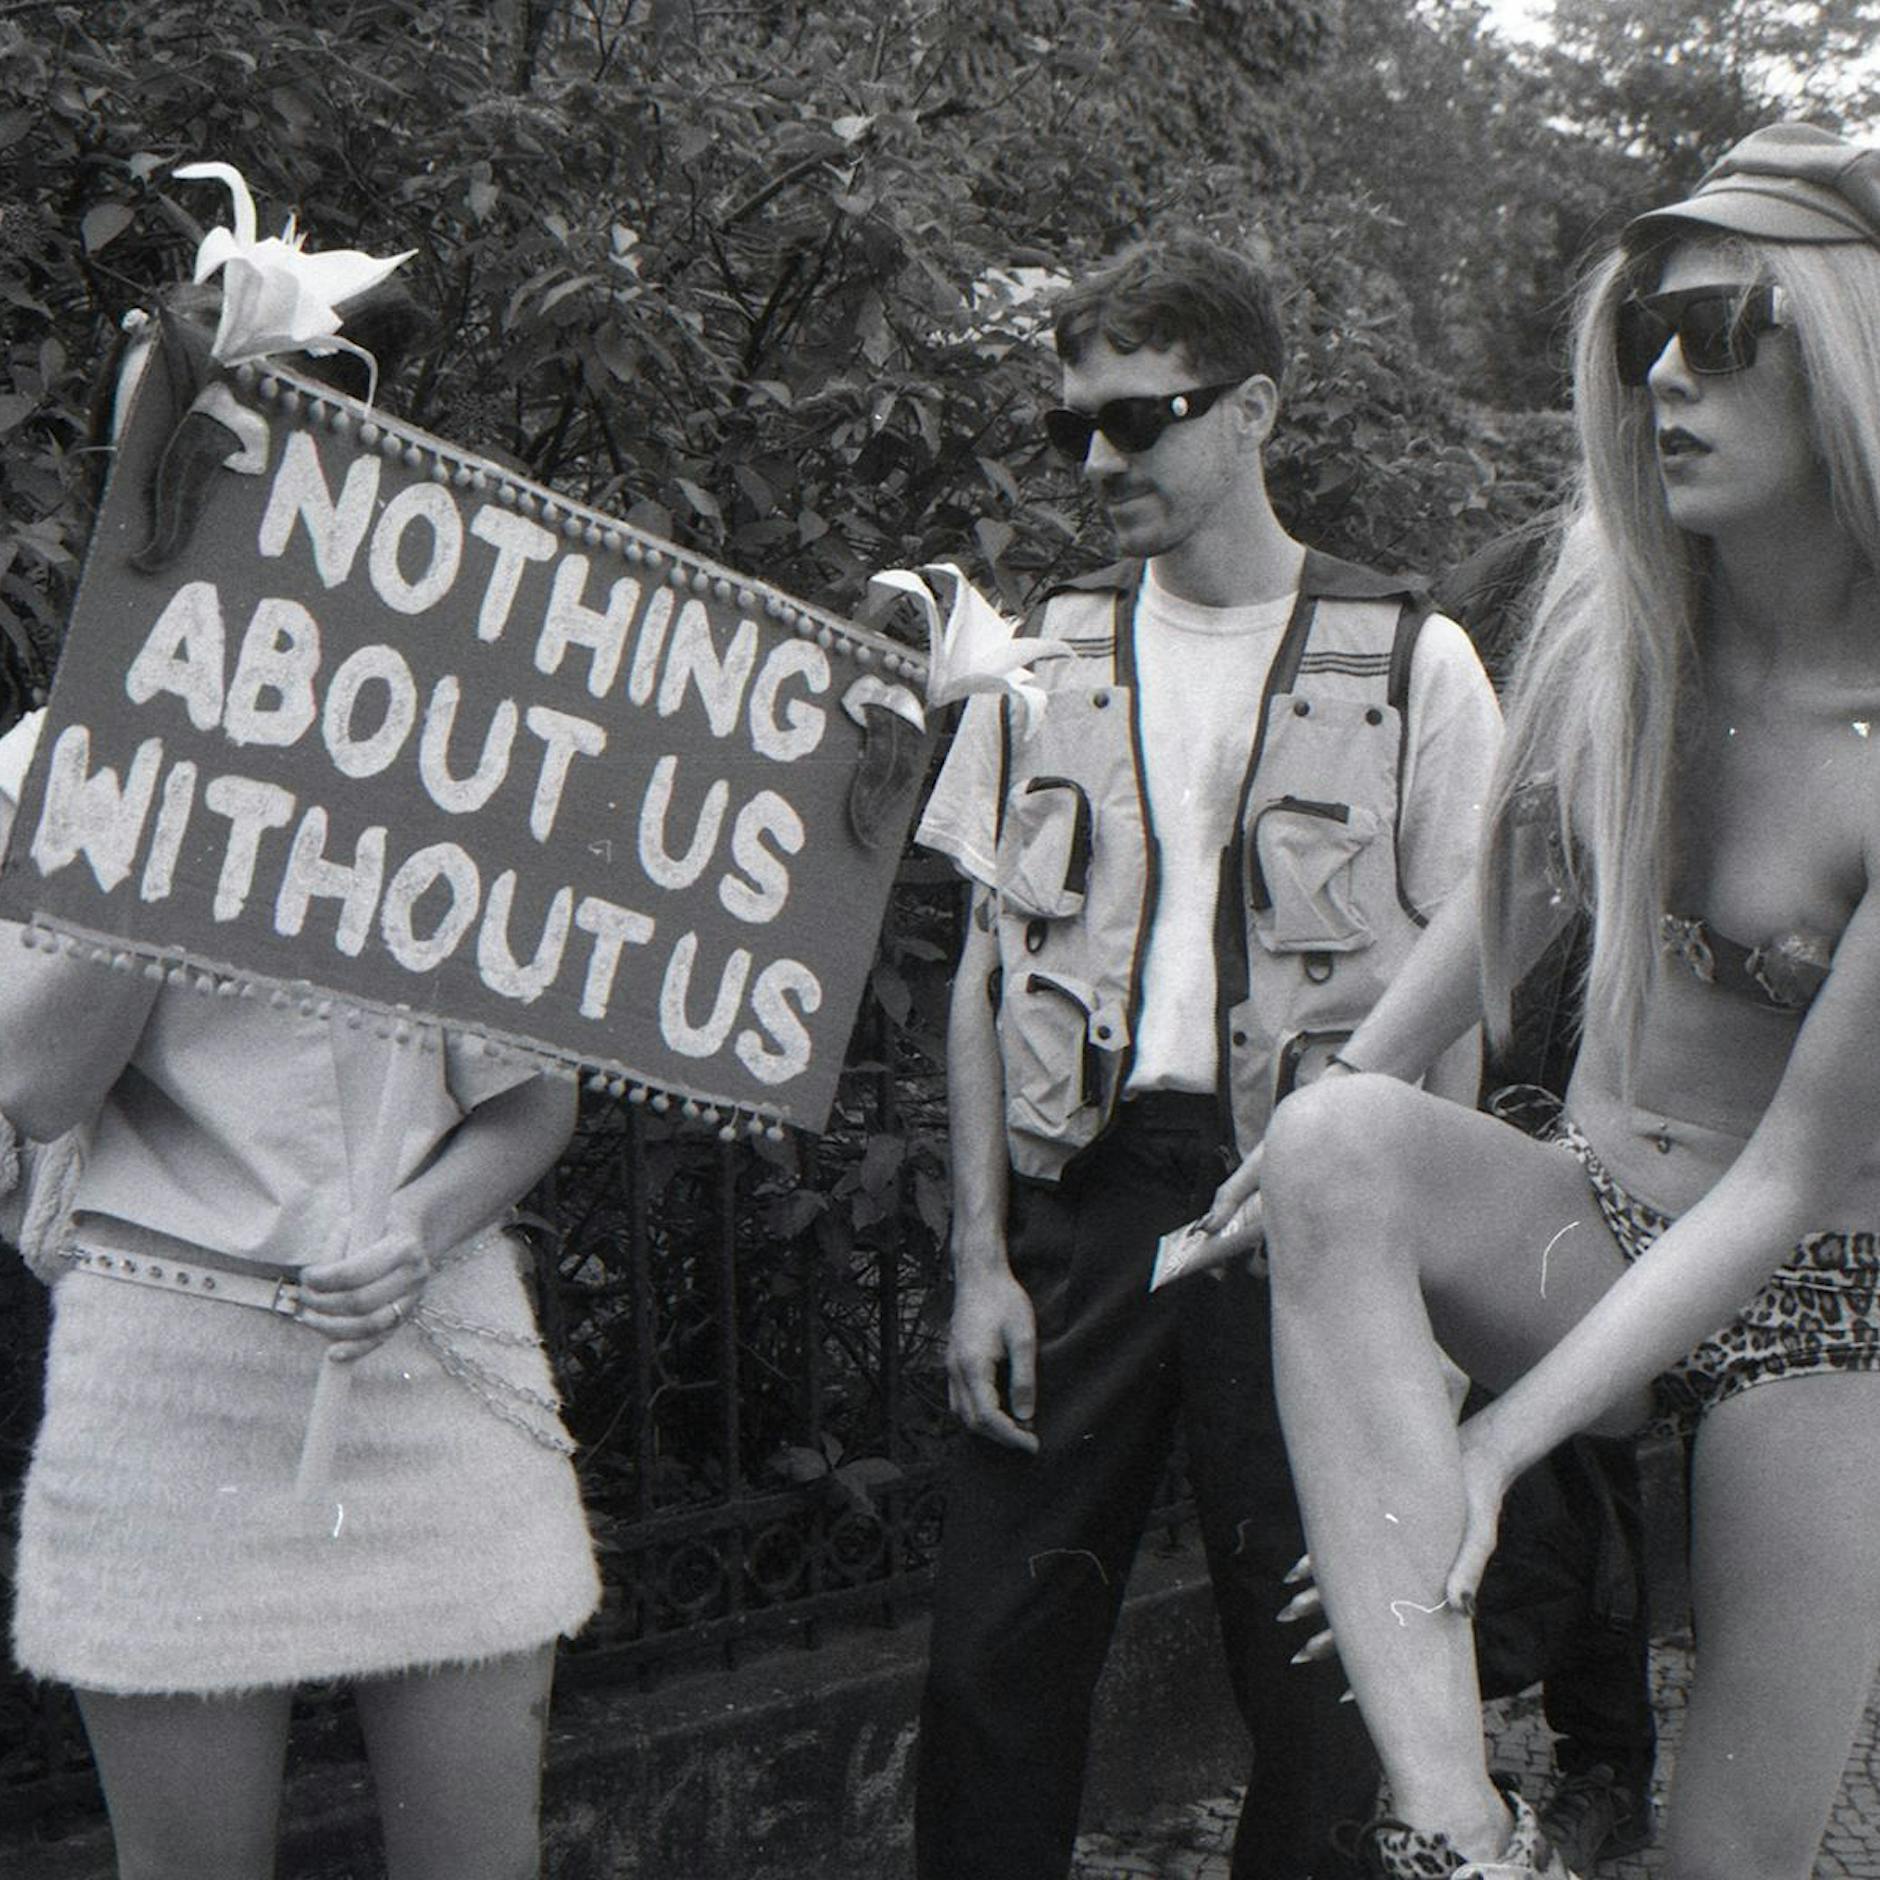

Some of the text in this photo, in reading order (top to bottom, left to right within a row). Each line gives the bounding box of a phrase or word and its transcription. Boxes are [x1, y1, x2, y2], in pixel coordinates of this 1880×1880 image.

[127, 582, 805, 923] ABOUT US
[260, 432, 830, 761] NOTHING
[31, 725, 822, 1085] WITHOUT US
